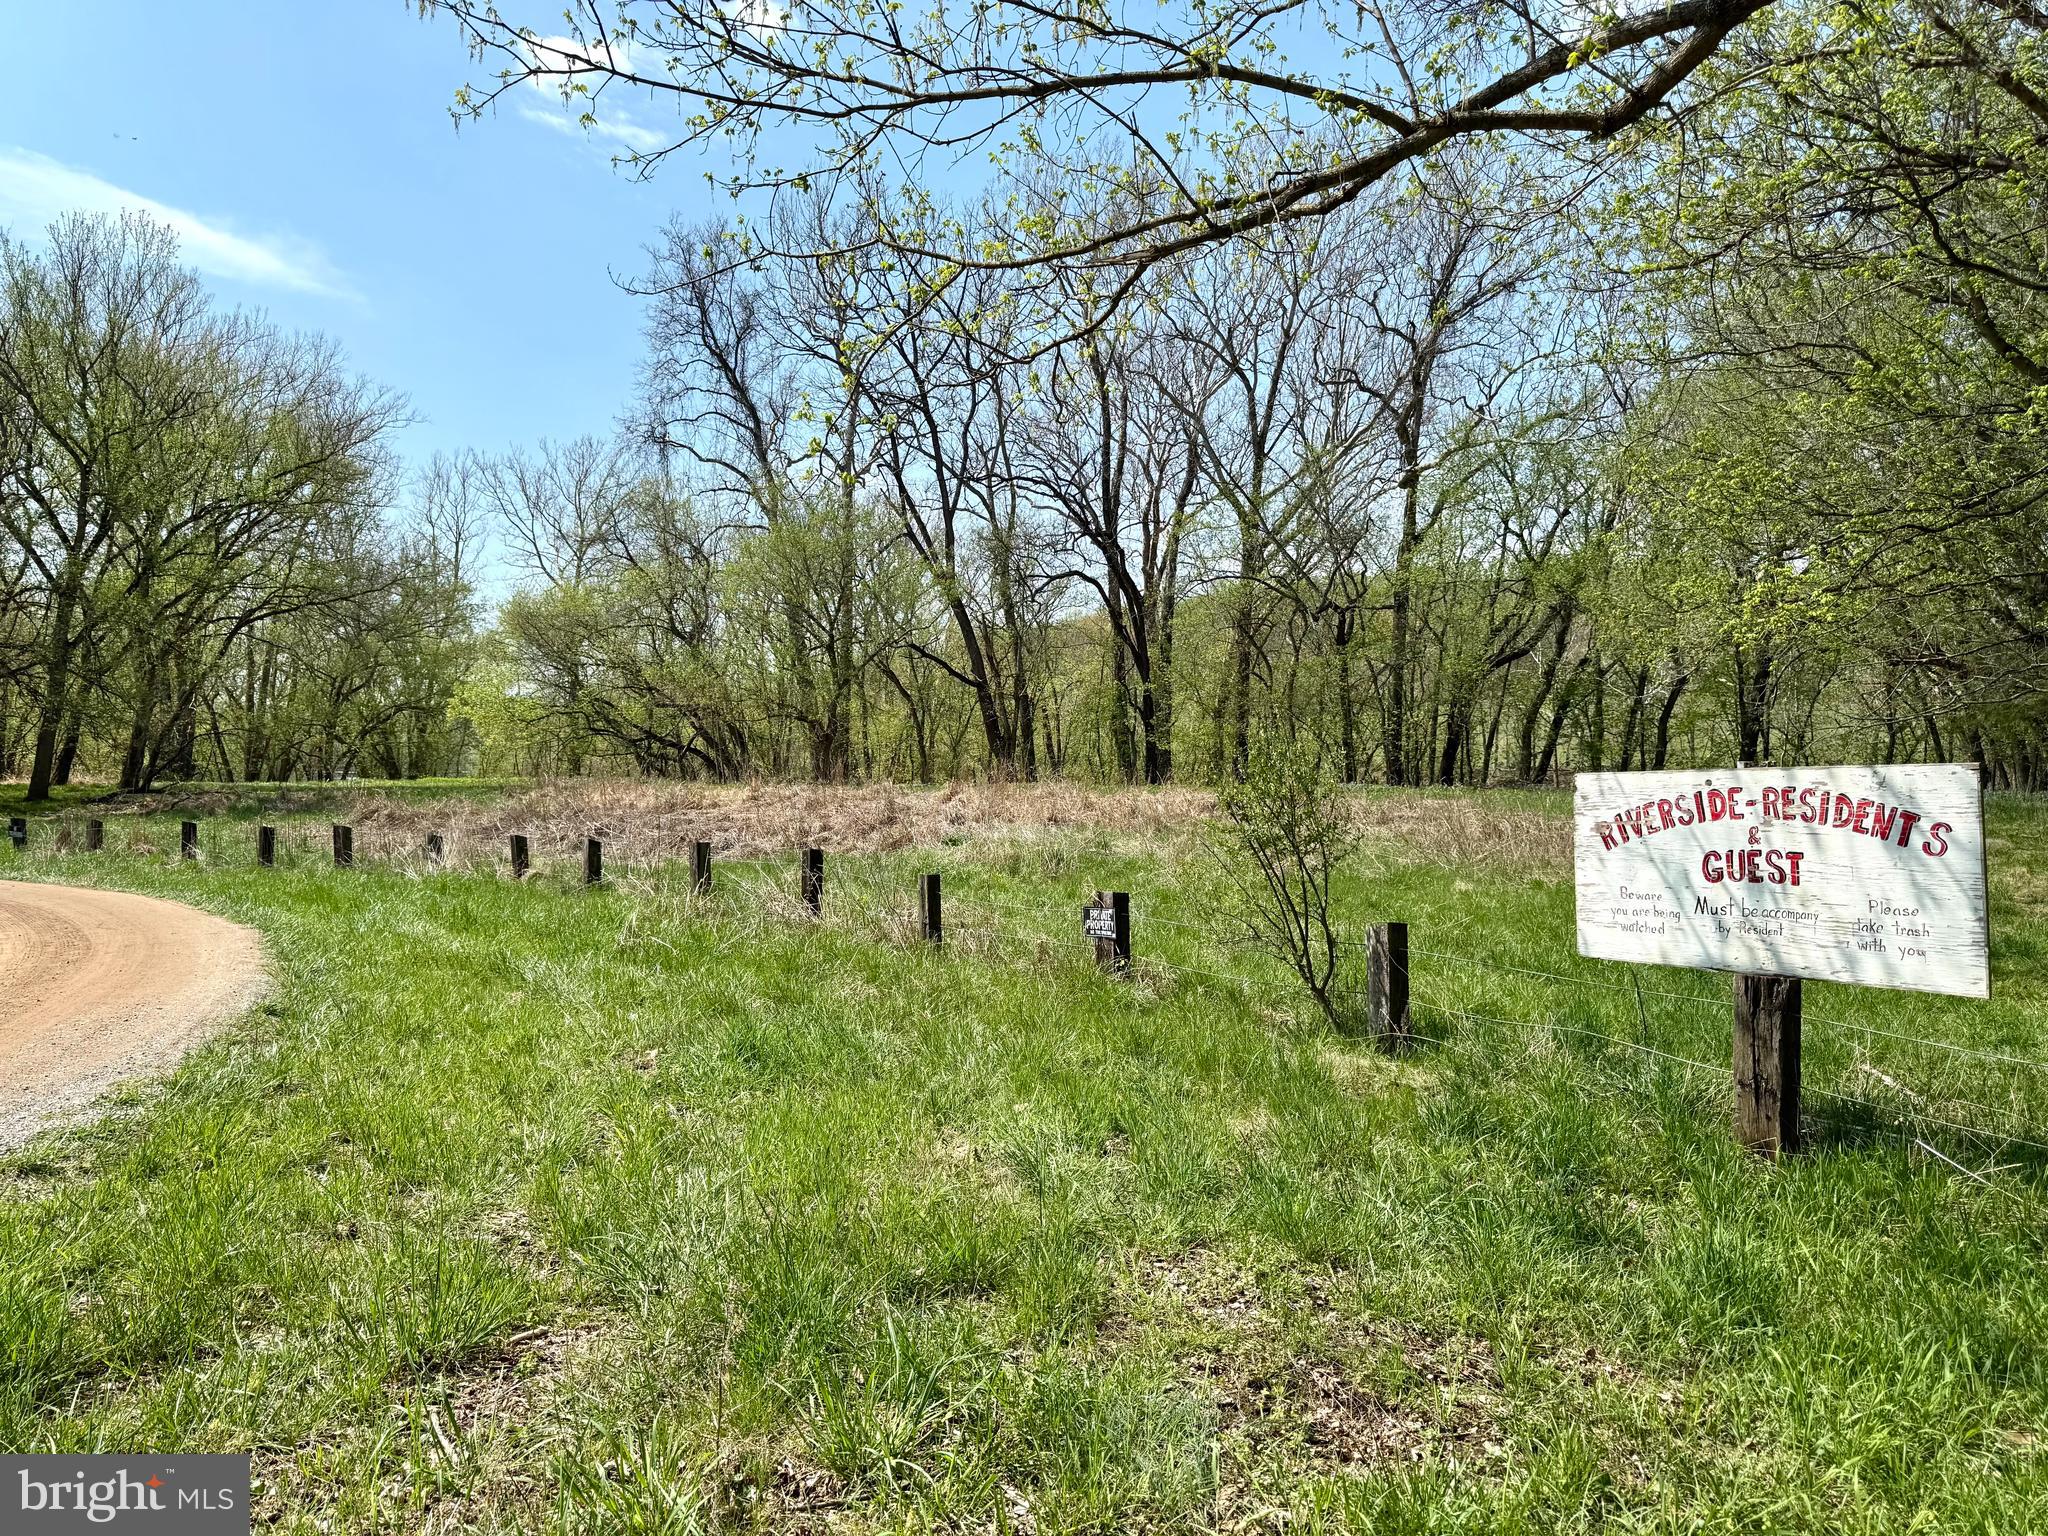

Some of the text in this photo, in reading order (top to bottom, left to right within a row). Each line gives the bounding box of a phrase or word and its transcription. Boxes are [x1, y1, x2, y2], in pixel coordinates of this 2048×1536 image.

[1747, 825, 1762, 845] &
[1702, 849, 1804, 887] GUEST
[1620, 885, 1663, 902] Beware
[1610, 904, 1681, 923] you are being
[1694, 895, 1819, 925] Must be accompany
[1868, 899, 1919, 917] Please
[1086, 919, 1114, 931] PROPERTY
[1620, 920, 1665, 934] watched
[1718, 920, 1785, 939] by Resident
[1891, 920, 1930, 937] trash
[1857, 937, 1927, 963] with you
